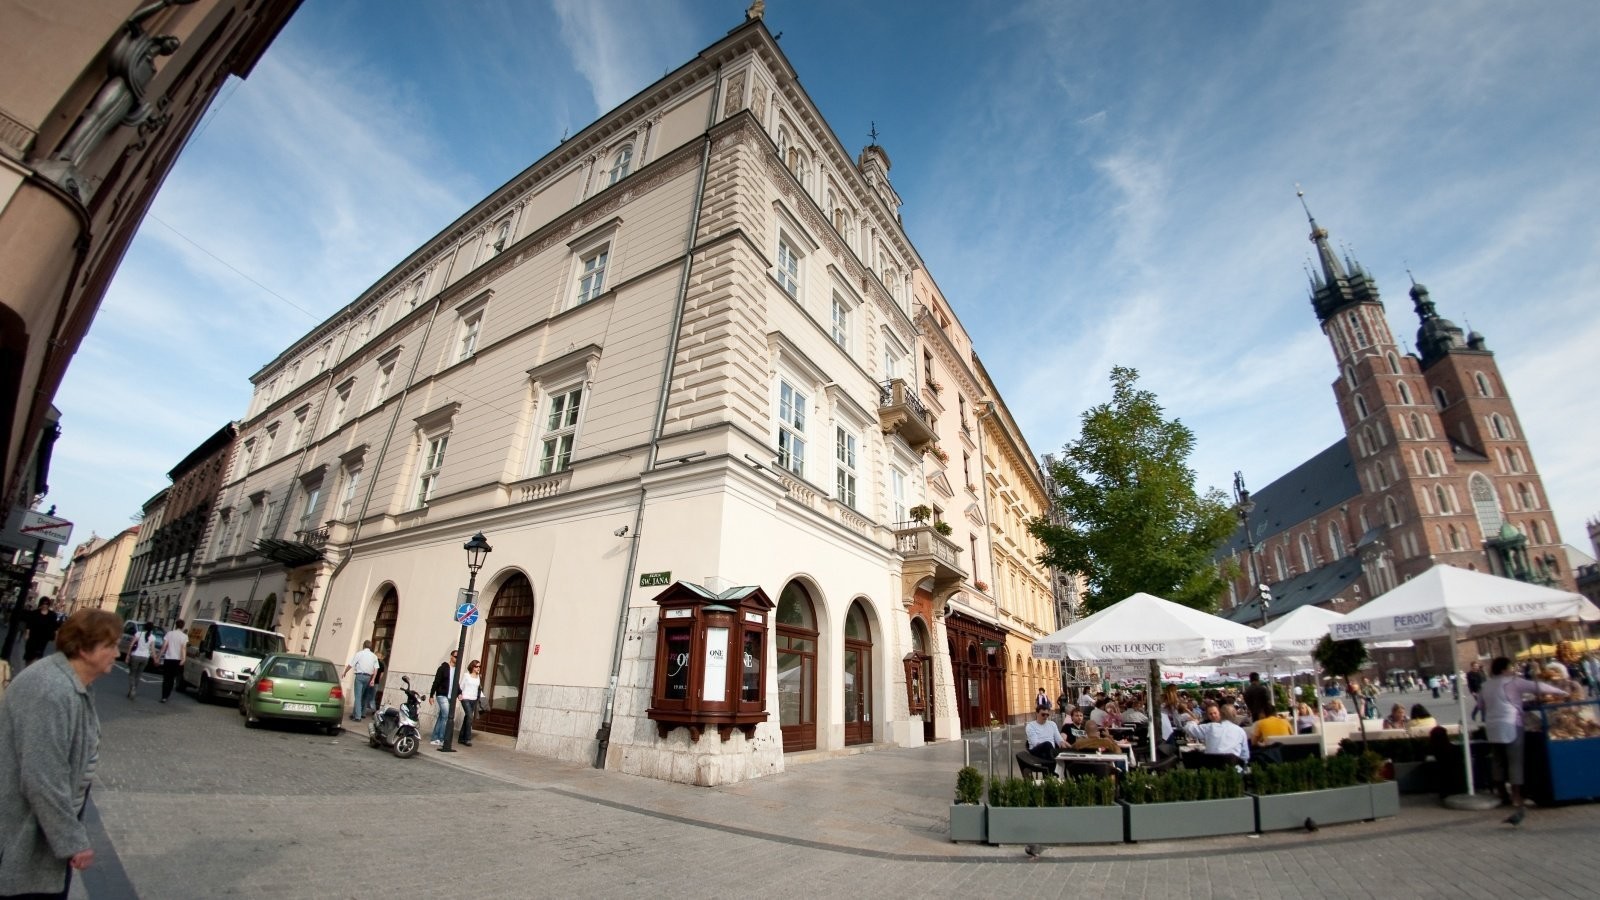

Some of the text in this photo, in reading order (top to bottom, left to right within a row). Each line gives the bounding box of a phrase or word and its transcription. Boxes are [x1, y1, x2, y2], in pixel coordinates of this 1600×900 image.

[652, 576, 669, 586] JANA
[1393, 612, 1433, 627] PERONI
[1336, 621, 1371, 634] PERONI
[1101, 643, 1166, 655] ONE LOUNGE
[1211, 638, 1235, 650] PERONI
